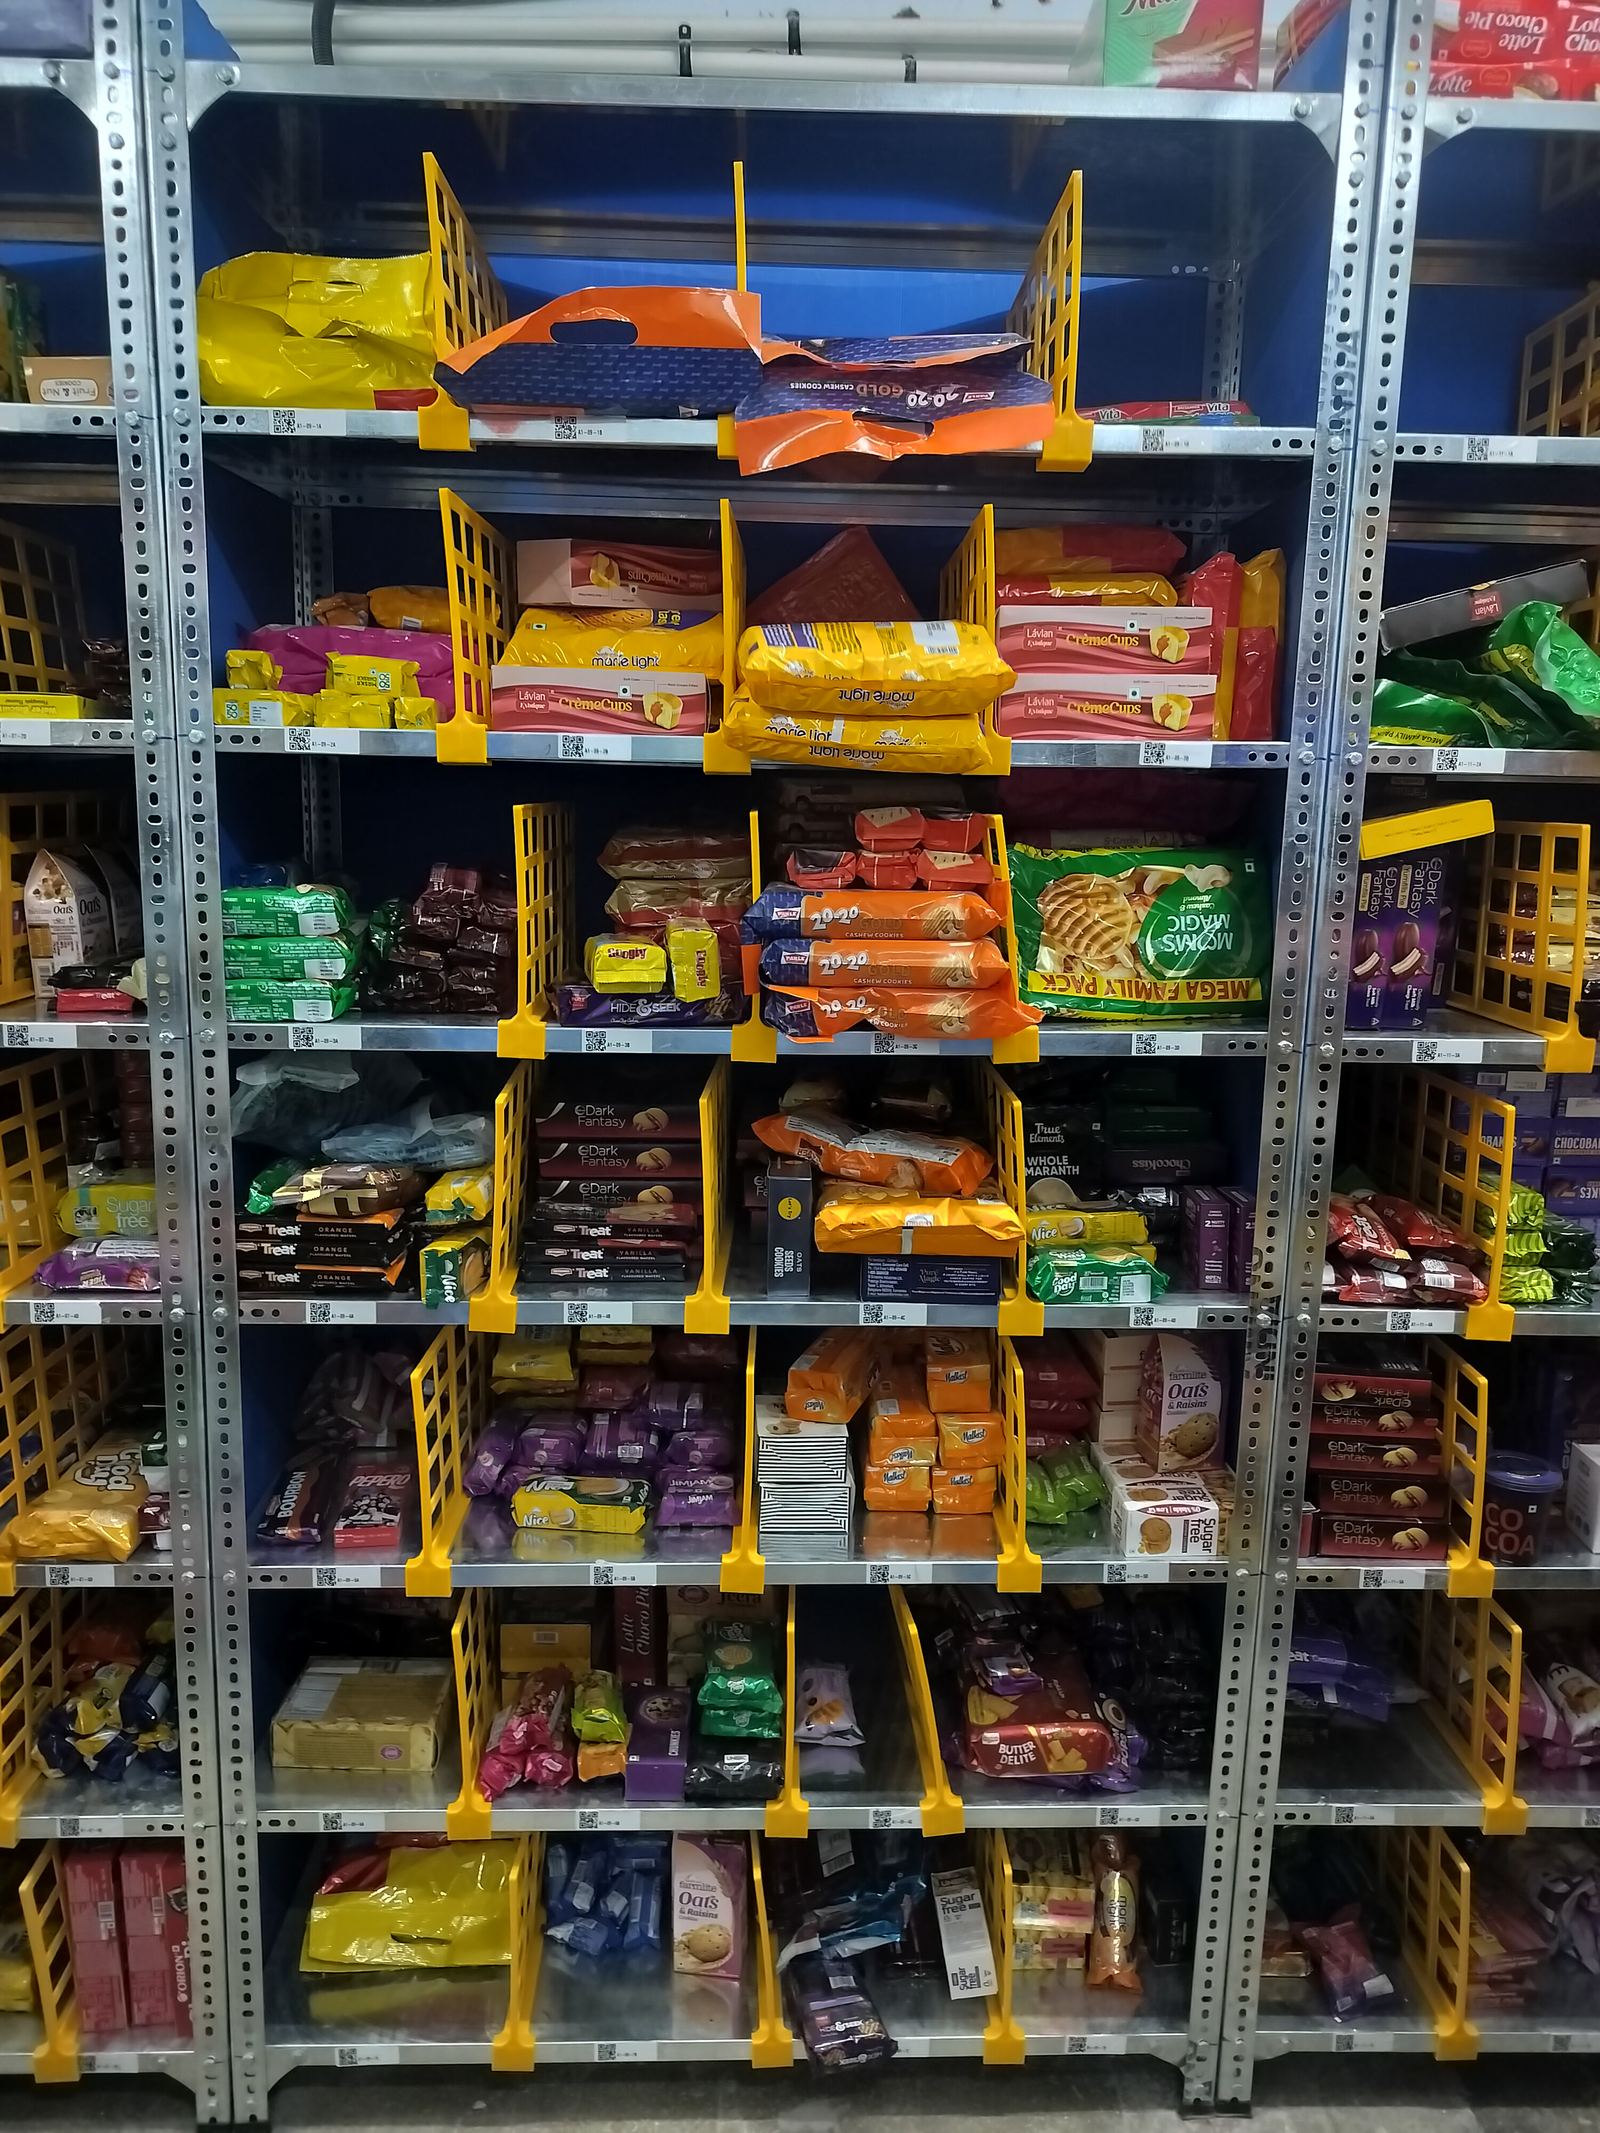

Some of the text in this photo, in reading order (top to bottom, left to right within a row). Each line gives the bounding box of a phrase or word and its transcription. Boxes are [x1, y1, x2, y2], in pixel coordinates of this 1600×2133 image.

[1465, 11, 1548, 34] Choco Pie
[1499, 33, 1547, 55] Lotte
[790, 382, 822, 390] COOKIES
[824, 382, 854, 391] CASHEW
[1027, 627, 1053, 638] Lávian
[1066, 633, 1139, 647] CrèmeCups
[592, 656, 659, 670] marie light
[519, 690, 545, 701] Lávian
[839, 689, 915, 702] marie light
[1027, 696, 1054, 706] Lávian
[558, 697, 633, 712] CrèmeCups
[1067, 701, 1142, 715] CrèmeCups
[809, 745, 885, 760] marie light
[1368, 869, 1387, 920] Fantasy
[1383, 878, 1397, 909] Dark
[1408, 861, 1431, 920] Fantasy
[1426, 870, 1442, 906] Dark
[1182, 895, 1212, 904] Almond
[52, 905, 74, 915] Oats
[810, 907, 860, 930] 20-20
[1168, 914, 1231, 931] MAGIC
[845, 931, 904, 939] CASHEW COOKIES
[696, 950, 708, 989] Googly
[819, 952, 869, 975] 20-20
[1043, 973, 1250, 1000] MEGA FAMILY PACK
[611, 997, 682, 1017] HIDE & SEEK
[820, 996, 867, 1018] 20-20
[585, 1105, 615, 1117] Dark
[577, 1116, 627, 1129] Fantasy
[1035, 1123, 1061, 1135] True
[1029, 1133, 1065, 1144] Elements
[589, 1145, 618, 1157] Dark
[581, 1156, 631, 1169] Fantasy
[1027, 1156, 1069, 1166] WHOLE
[1132, 1159, 1191, 1170] ChocoKiss
[1025, 1165, 1080, 1177] MARANTH
[590, 1183, 620, 1195] Dark
[116, 1212, 150, 1229] free
[265, 1225, 353, 1237] Treat ORANGE
[579, 1225, 612, 1237] Treat
[1031, 1228, 1058, 1241] Nice
[261, 1243, 349, 1256] Treat ORANGE
[570, 1249, 604, 1261] Treat
[773, 1247, 785, 1279] COOKIES
[784, 1250, 794, 1273] SEEDS
[796, 1252, 804, 1273] OATS
[265, 1271, 352, 1283] Treat ORANGE
[576, 1267, 609, 1279] Treat
[1053, 1273, 1078, 1287] Good
[439, 1273, 457, 1304] Nice
[1054, 1283, 1076, 1296] Day
[1168, 1382, 1209, 1399] Oats
[1365, 1388, 1410, 1398] Fantasy
[1168, 1399, 1208, 1409] & Raisins
[1374, 1397, 1398, 1407] Dark
[1335, 1406, 1361, 1417] Dark
[1326, 1416, 1371, 1427] Fantasy
[1339, 1442, 1365, 1454] Dark
[1330, 1452, 1375, 1464] Fantasy
[349, 1474, 411, 1490] PEPERO
[1343, 1481, 1372, 1493] Dark
[277, 1472, 308, 1520] BOURBON
[1333, 1491, 1384, 1506] Fantasy
[523, 1514, 550, 1527] Nice
[1485, 1503, 1524, 1531] CO
[1190, 1518, 1206, 1543] free
[1344, 1522, 1373, 1534] Dark
[1202, 1518, 1216, 1554] Sugar
[1335, 1534, 1385, 1547] Fantasy
[1485, 1533, 1535, 1557] COA
[621, 1613, 635, 1653] Lotte
[636, 1610, 650, 1656] Choco
[998, 1741, 1037, 1755] BUTTER
[1000, 1751, 1037, 1765] DELITE
[678, 1891, 719, 1910] Oats
[940, 1892, 976, 1907] Sugar
[687, 1908, 719, 1919] Raisins
[942, 1904, 967, 1914] free
